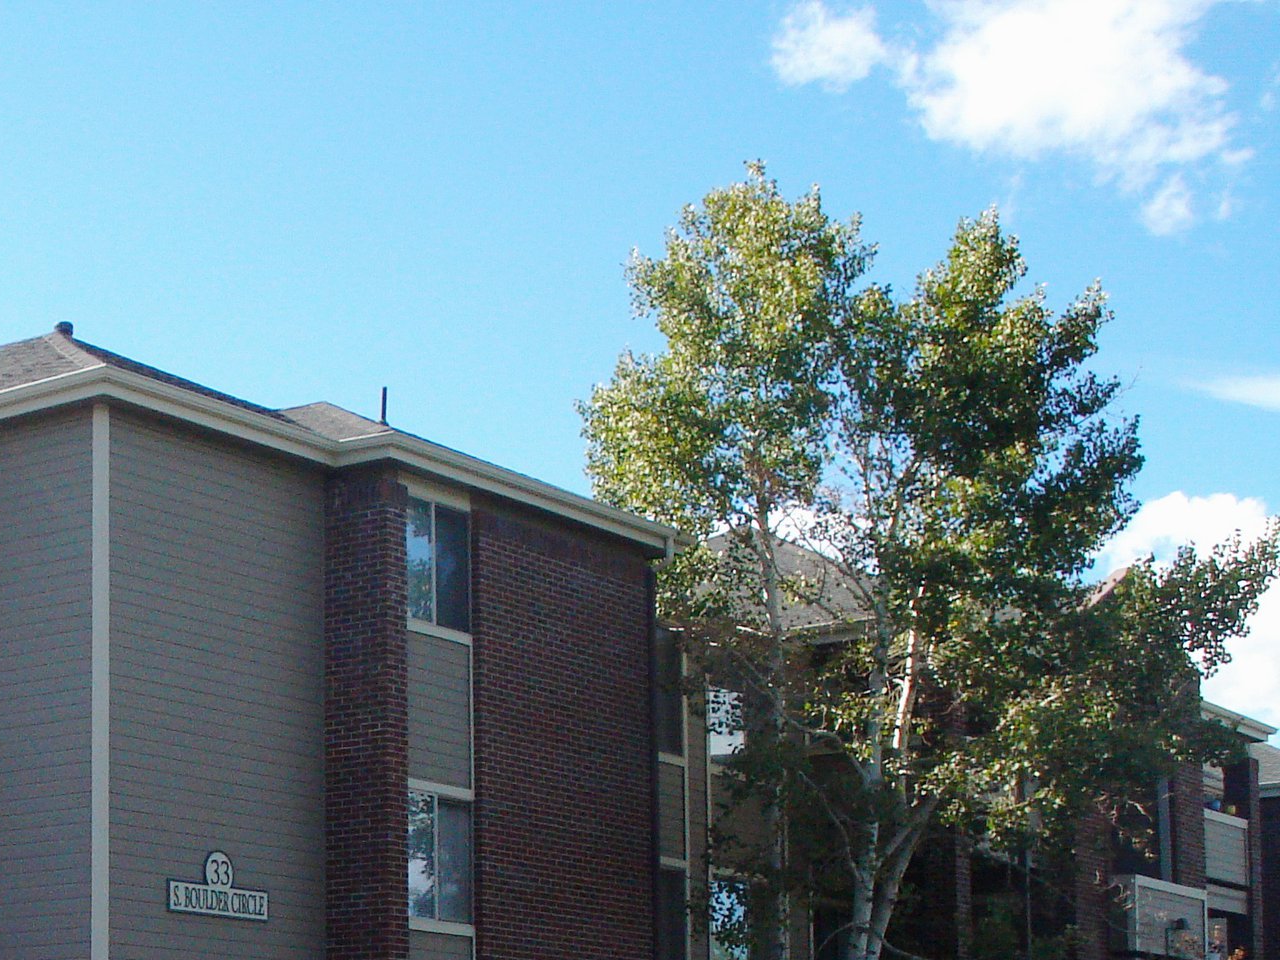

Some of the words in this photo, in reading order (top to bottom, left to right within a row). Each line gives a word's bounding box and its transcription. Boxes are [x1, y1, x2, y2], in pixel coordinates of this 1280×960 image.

[211, 859, 230, 885] 33
[173, 885, 182, 907] S.
[184, 886, 230, 913] BOULDER
[231, 892, 265, 916] CIRCLE
